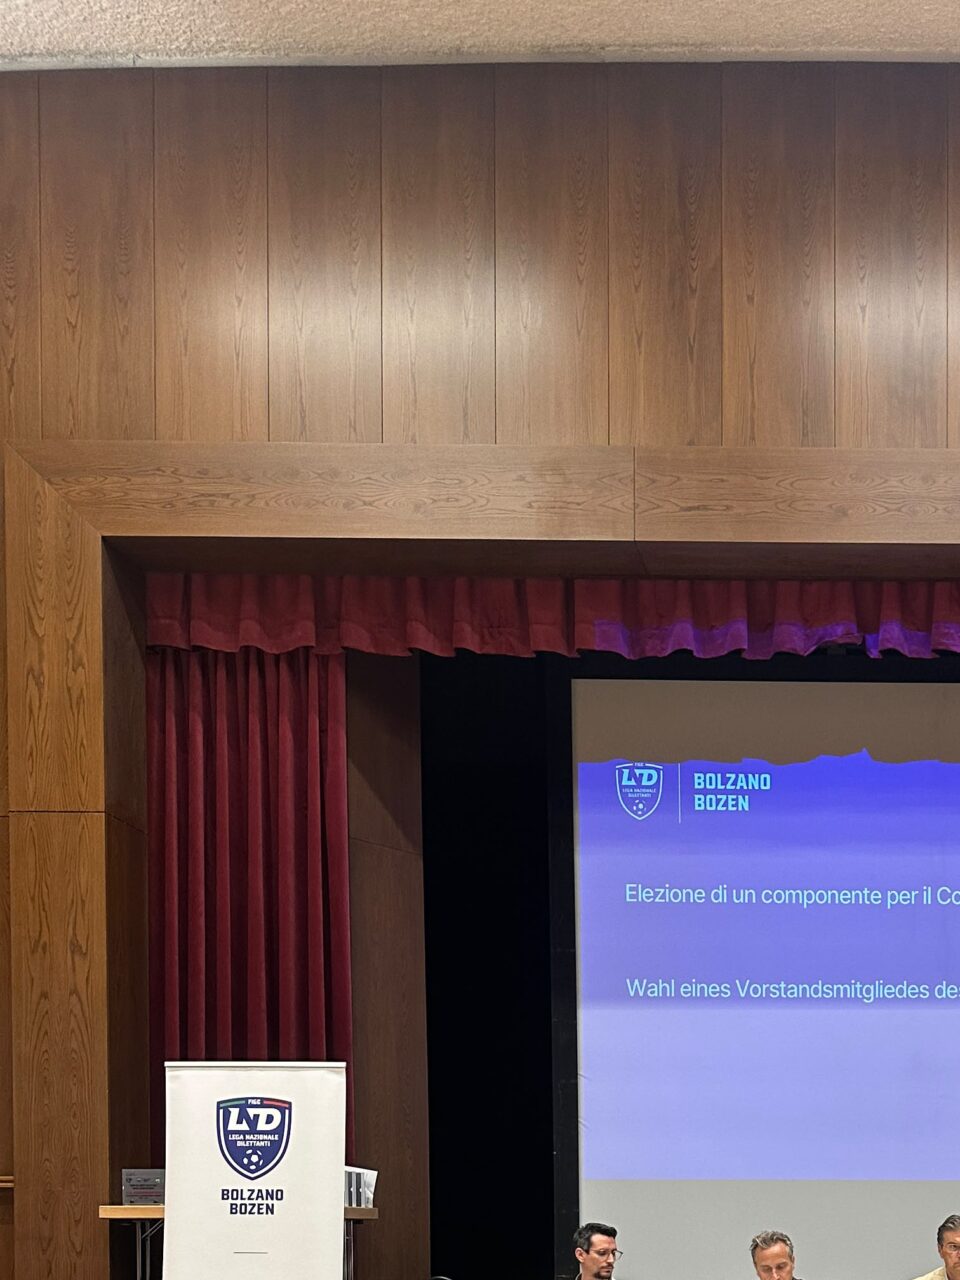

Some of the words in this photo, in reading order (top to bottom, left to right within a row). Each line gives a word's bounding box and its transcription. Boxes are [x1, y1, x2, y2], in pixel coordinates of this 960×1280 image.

[694, 773, 771, 790] BOLZANO
[694, 794, 749, 811] BOZEN
[626, 884, 706, 903] Elezione
[711, 884, 728, 903] di
[733, 889, 756, 904] un
[762, 888, 881, 909] componente
[887, 890, 918, 909] per
[923, 886, 932, 905] il
[626, 979, 675, 998] Wahl
[680, 979, 731, 998] eines
[736, 980, 930, 1003] Vorstandsmitgliedes
[227, 1107, 282, 1131] LND
[221, 1188, 284, 1202] BOLZANO
[229, 1202, 275, 1216] BOZEN
